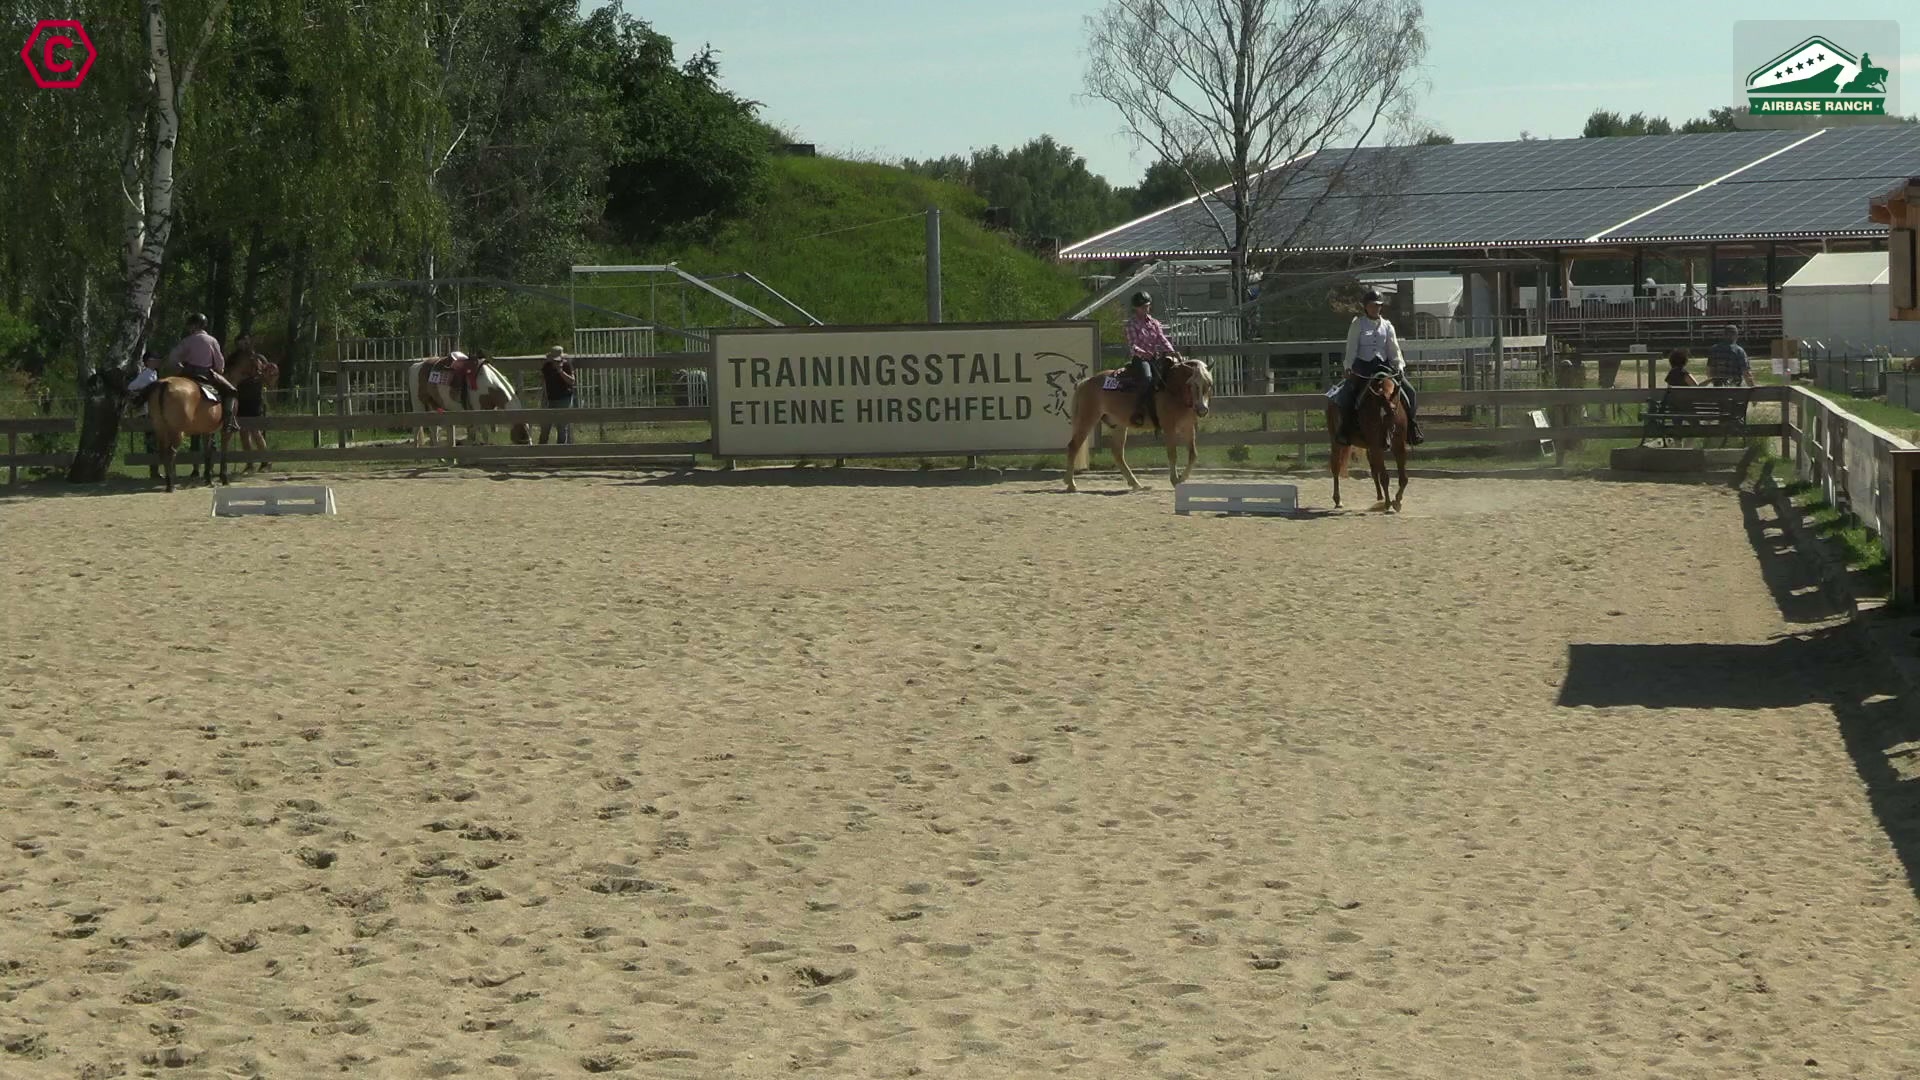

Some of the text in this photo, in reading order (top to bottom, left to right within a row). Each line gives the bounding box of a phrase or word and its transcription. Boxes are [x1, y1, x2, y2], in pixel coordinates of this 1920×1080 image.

[728, 352, 1033, 388] TRAININGSSTALL
[730, 395, 1033, 425] ETIENNE HIRSCHFELD
